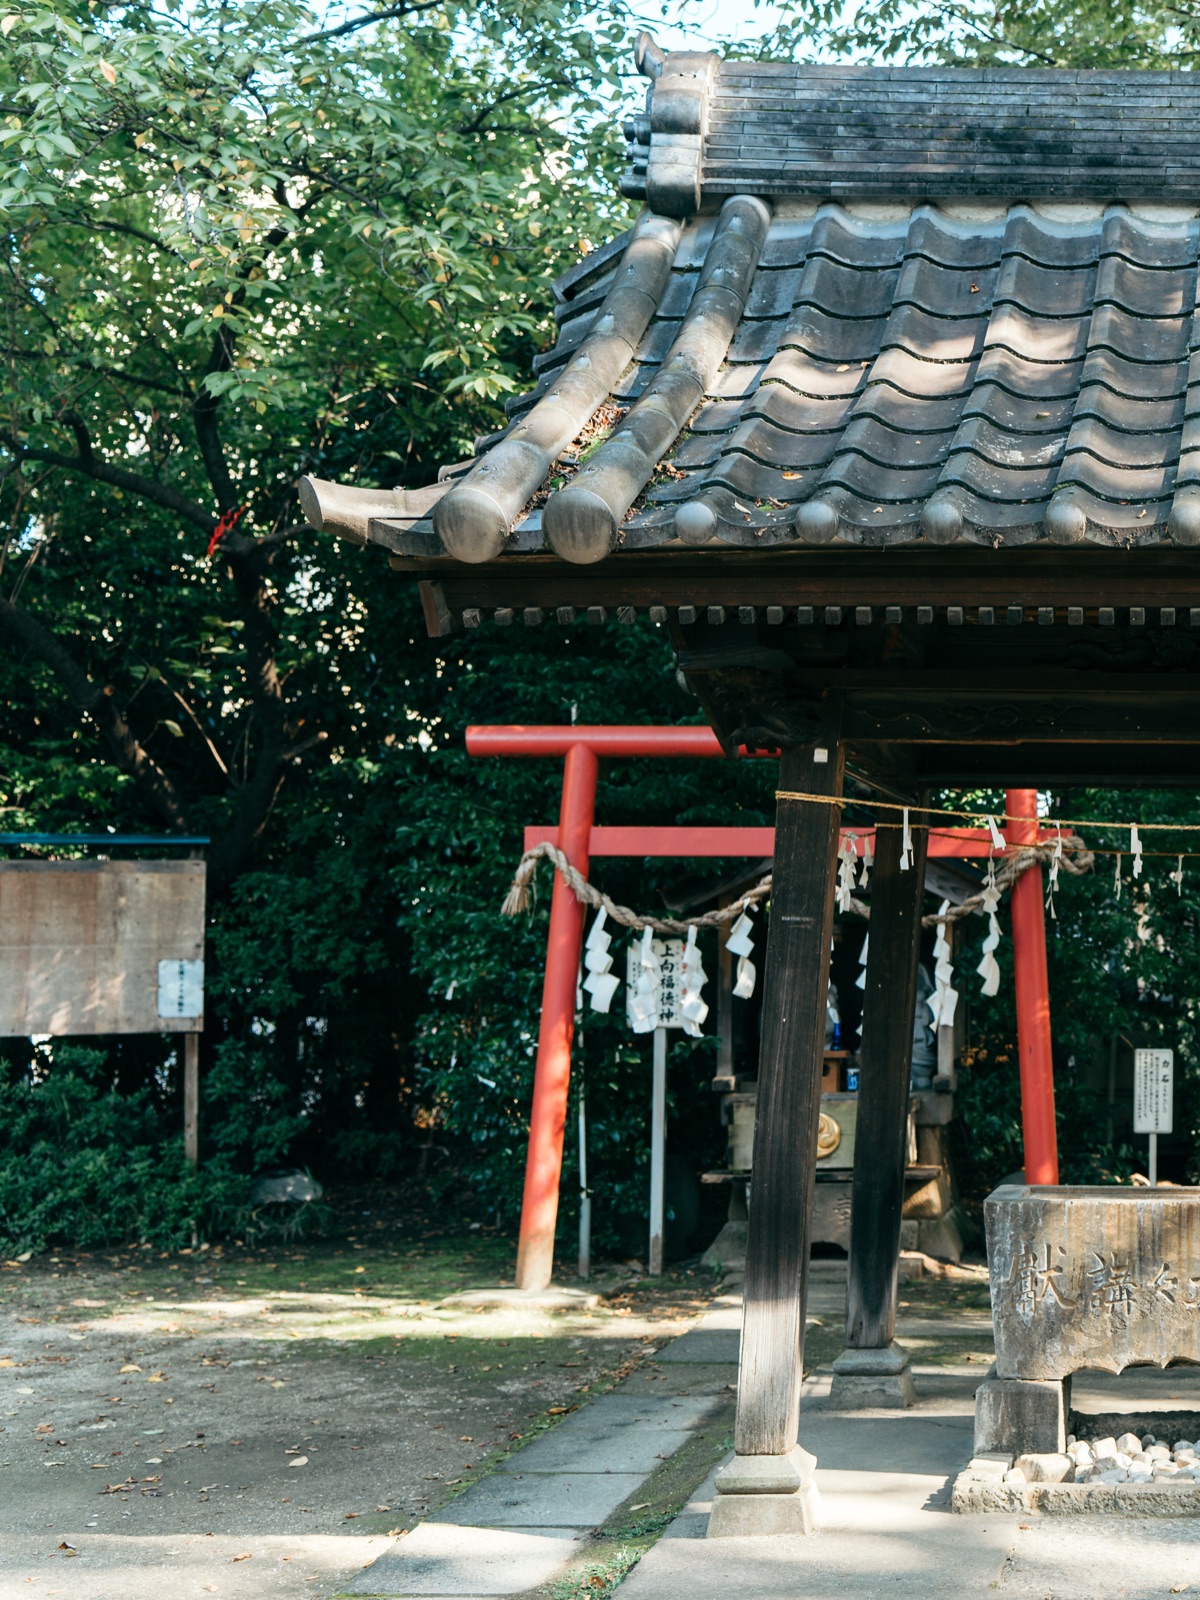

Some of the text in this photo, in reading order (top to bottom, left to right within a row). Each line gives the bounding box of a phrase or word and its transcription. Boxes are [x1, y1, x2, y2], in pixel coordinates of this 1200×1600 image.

[659, 944, 675, 1023] 上向福徳神
